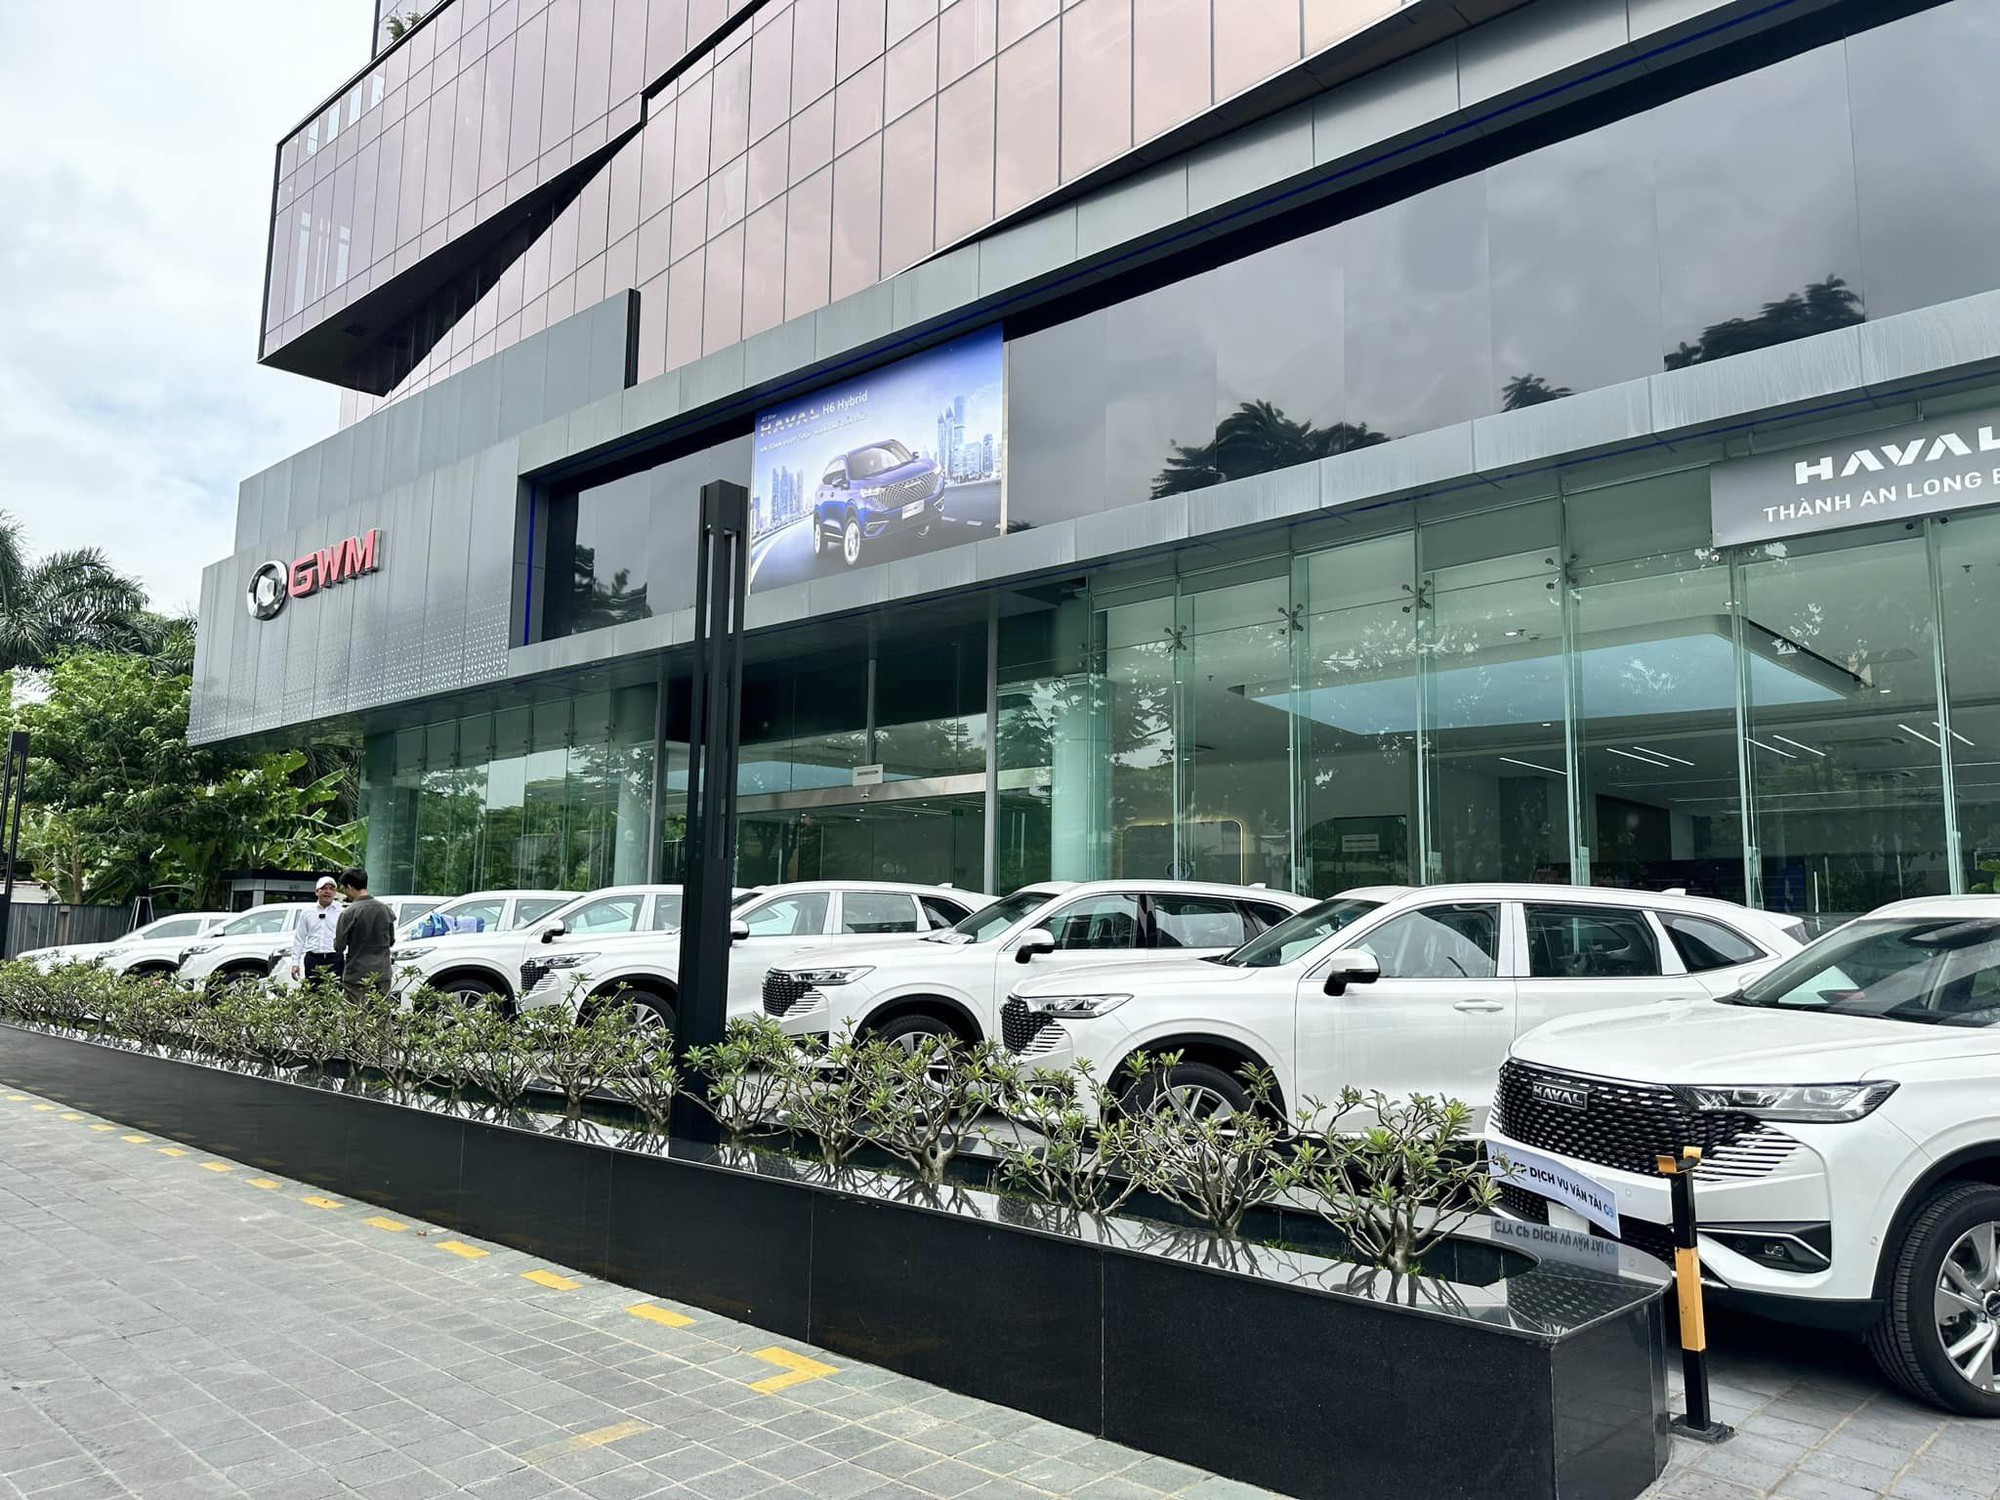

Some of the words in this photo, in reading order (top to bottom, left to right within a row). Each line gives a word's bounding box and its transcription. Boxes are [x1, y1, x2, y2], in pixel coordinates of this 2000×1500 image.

[760, 408, 820, 437] HAVAL
[822, 404, 835, 415] H6
[837, 390, 868, 411] Hybrid
[1795, 425, 2000, 485] HAVAL
[1763, 493, 1851, 523] THÀNH
[1860, 485, 1897, 507] AN
[1906, 471, 1982, 499] LONG
[288, 528, 381, 598] GWM
[1534, 1085, 1584, 1106] HAVAL
[1530, 1166, 1555, 1184] DỊCH
[1556, 1176, 1569, 1194] VỤ
